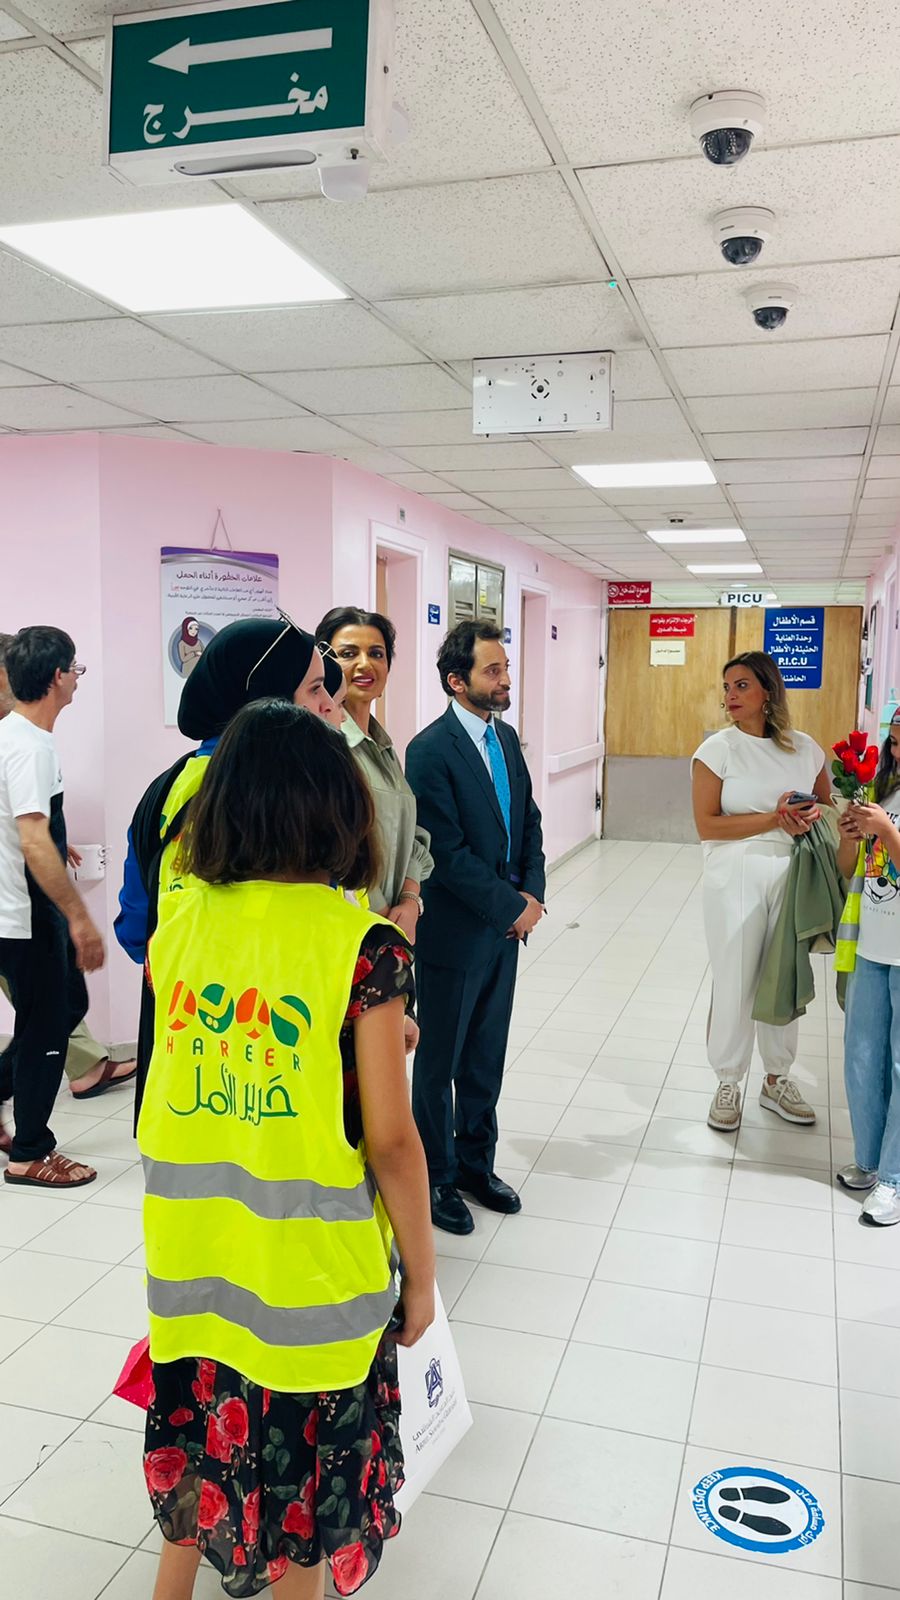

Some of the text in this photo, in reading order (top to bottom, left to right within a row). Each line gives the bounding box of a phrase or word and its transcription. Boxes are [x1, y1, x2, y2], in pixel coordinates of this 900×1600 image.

[143, 72, 329, 144] مخرج
[176, 571, 198, 579] الحمل
[199, 570, 214, 580] أثناء
[727, 593, 762, 603] PICU
[772, 613, 816, 627] قسم الأطفال
[775, 633, 812, 643] وحدة العناية
[778, 657, 808, 666] P.I.C.U
[166, 1036, 302, 1072] HAREER
[693, 1471, 724, 1533] KEEP DISTANCE
